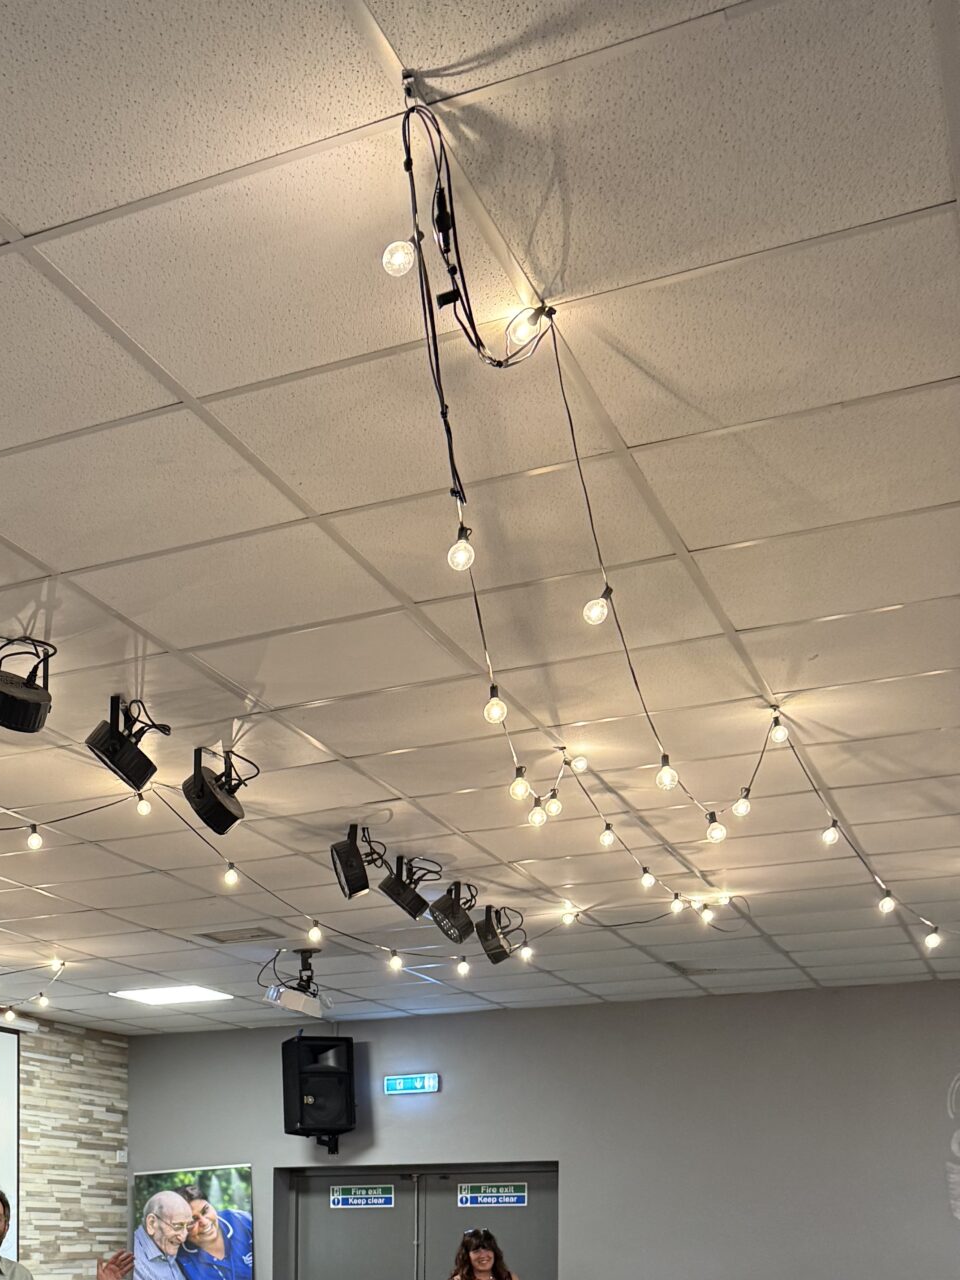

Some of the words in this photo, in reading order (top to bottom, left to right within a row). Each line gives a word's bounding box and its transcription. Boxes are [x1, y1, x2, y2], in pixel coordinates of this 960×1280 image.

[351, 1187, 367, 1195] Fire
[368, 1187, 382, 1195] exit
[481, 1185, 497, 1193] Fire
[499, 1185, 514, 1193] exit
[348, 1197, 366, 1206] Keep
[367, 1196, 385, 1204] clear
[477, 1196, 497, 1205] Keep
[498, 1195, 517, 1203] clear
